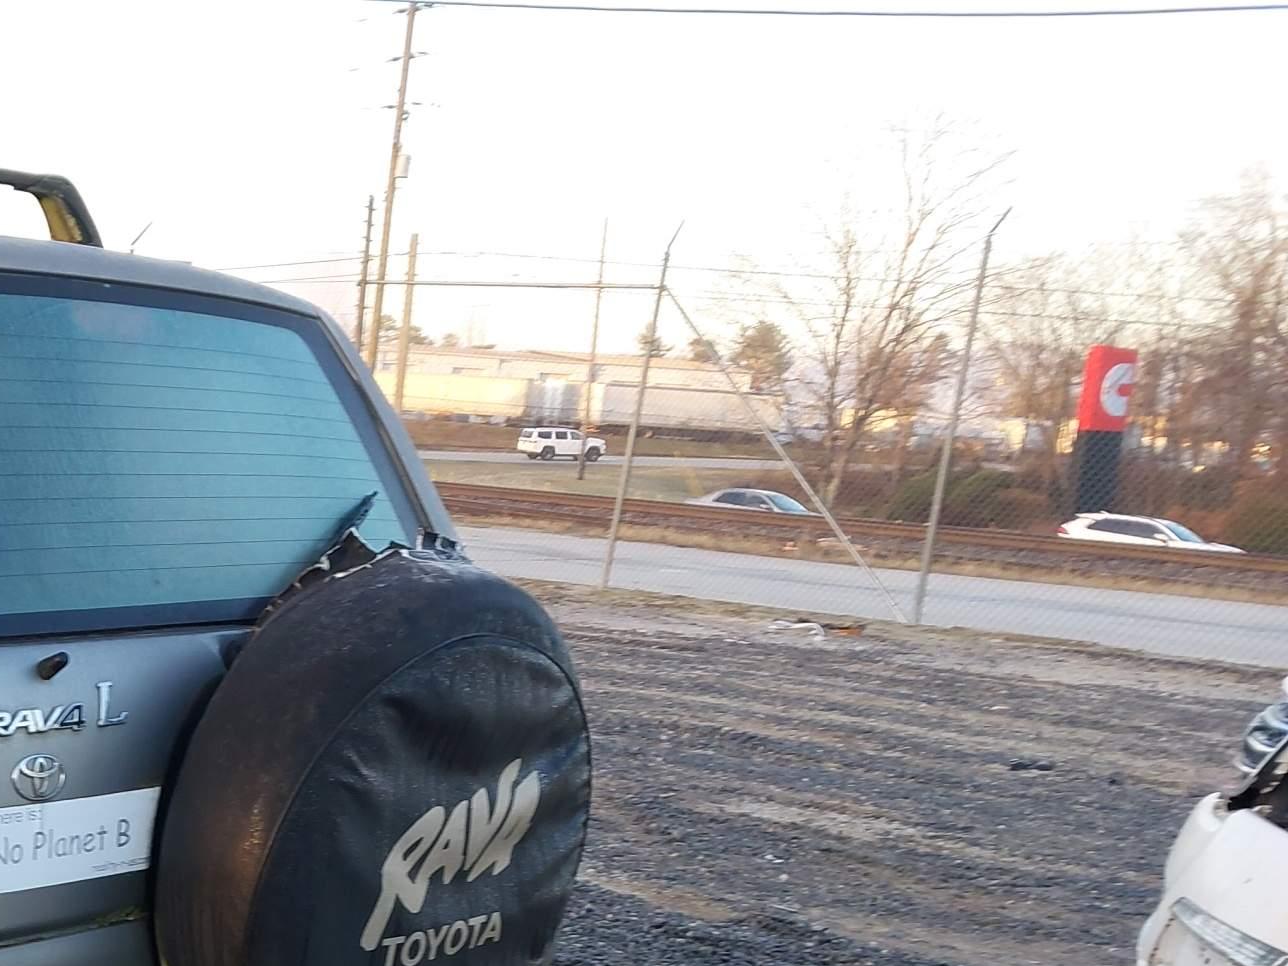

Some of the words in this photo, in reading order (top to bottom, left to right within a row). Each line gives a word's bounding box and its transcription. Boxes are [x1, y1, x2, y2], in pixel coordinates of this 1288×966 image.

[96, 681, 129, 728] L
[32, 825, 108, 861] Planet
[116, 818, 132, 848] B
